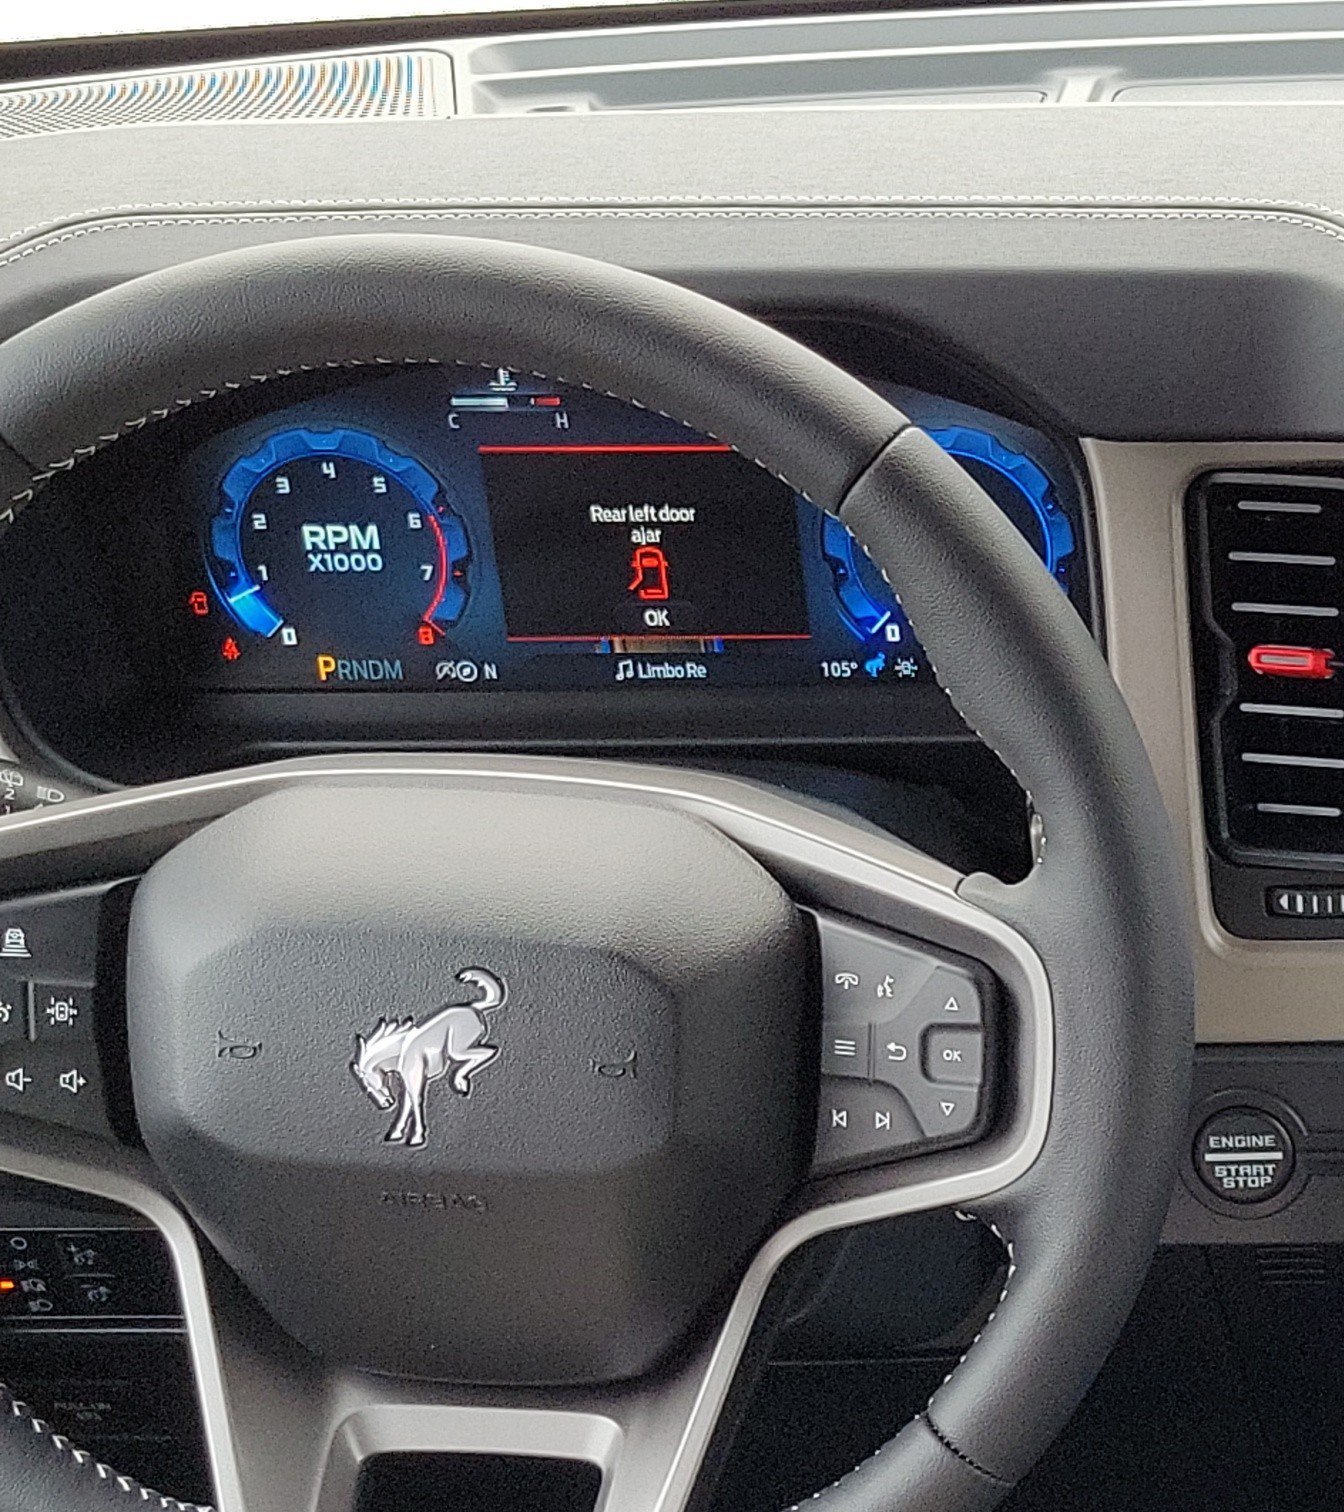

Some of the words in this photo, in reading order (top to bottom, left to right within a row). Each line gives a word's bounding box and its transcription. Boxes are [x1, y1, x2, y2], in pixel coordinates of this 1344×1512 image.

[448, 413, 460, 429] C
[555, 411, 570, 429] H
[321, 461, 336, 479] 4
[275, 476, 291, 494] 3
[372, 476, 387, 493] 5
[252, 513, 267, 530] 2
[407, 512, 422, 529] 6
[590, 505, 627, 522] Rear
[628, 505, 657, 522] left
[659, 505, 696, 522] door
[302, 524, 381, 551] RPM
[631, 528, 662, 544] ajar
[307, 553, 383, 572] X1000
[257, 564, 269, 581] 1
[420, 564, 434, 581] 7
[644, 609, 671, 627] OK
[281, 627, 297, 645] 0
[417, 626, 434, 645] 8
[885, 623, 901, 642] 0
[484, 662, 498, 680] N
[637, 662, 684, 679] Limbo
[687, 663, 707, 678] Re
[942, 1049, 962, 1062] OK
[1208, 1134, 1277, 1149] ENGINE
[1213, 1163, 1277, 1177] START
[1222, 1176, 1273, 1189] STOP
